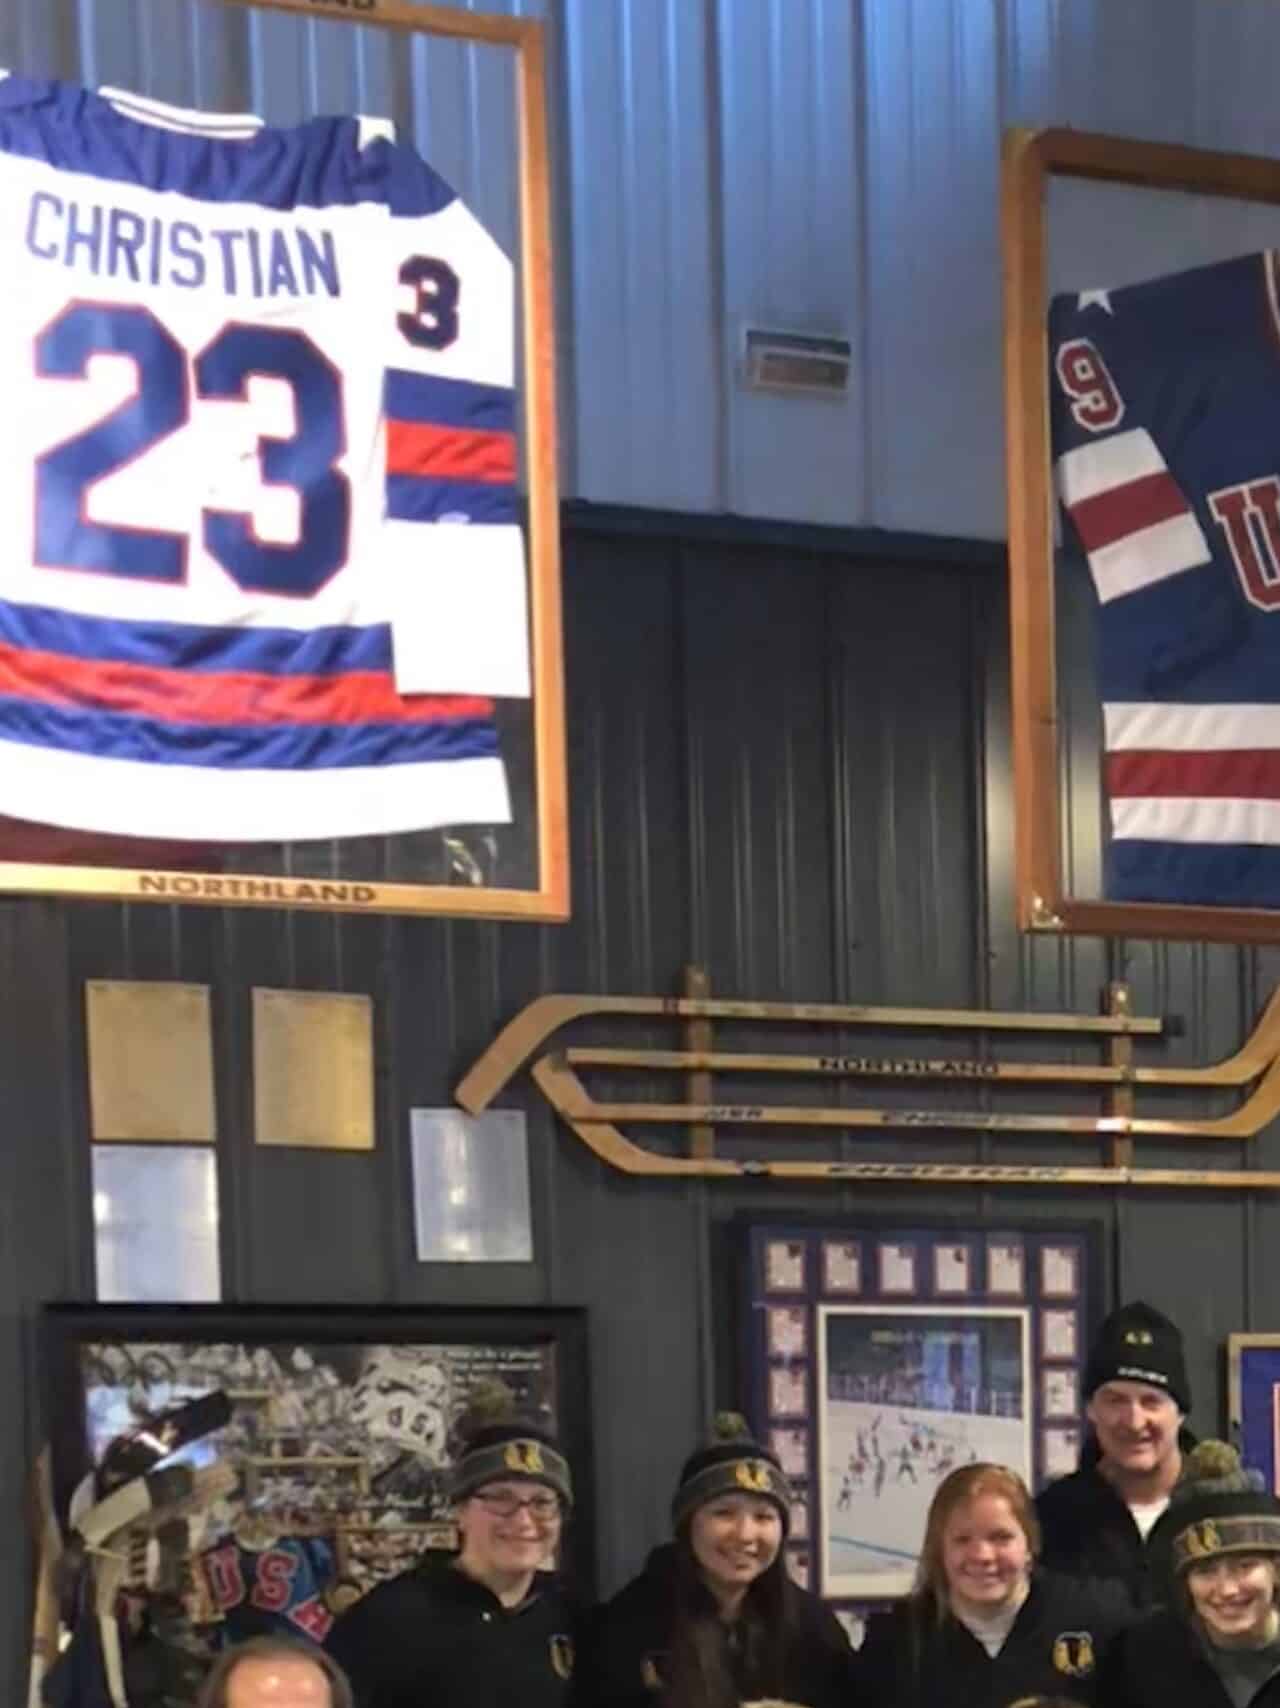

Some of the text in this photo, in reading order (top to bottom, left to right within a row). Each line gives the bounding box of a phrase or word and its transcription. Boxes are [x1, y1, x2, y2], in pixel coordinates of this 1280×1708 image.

[25, 191, 342, 299] CHRISTIAN
[1056, 339, 1126, 432] 9
[31, 297, 353, 600] 23
[138, 872, 378, 906] NORTHLAND
[817, 1056, 1000, 1078] NORTHLAND
[207, 1546, 336, 1642] USA
